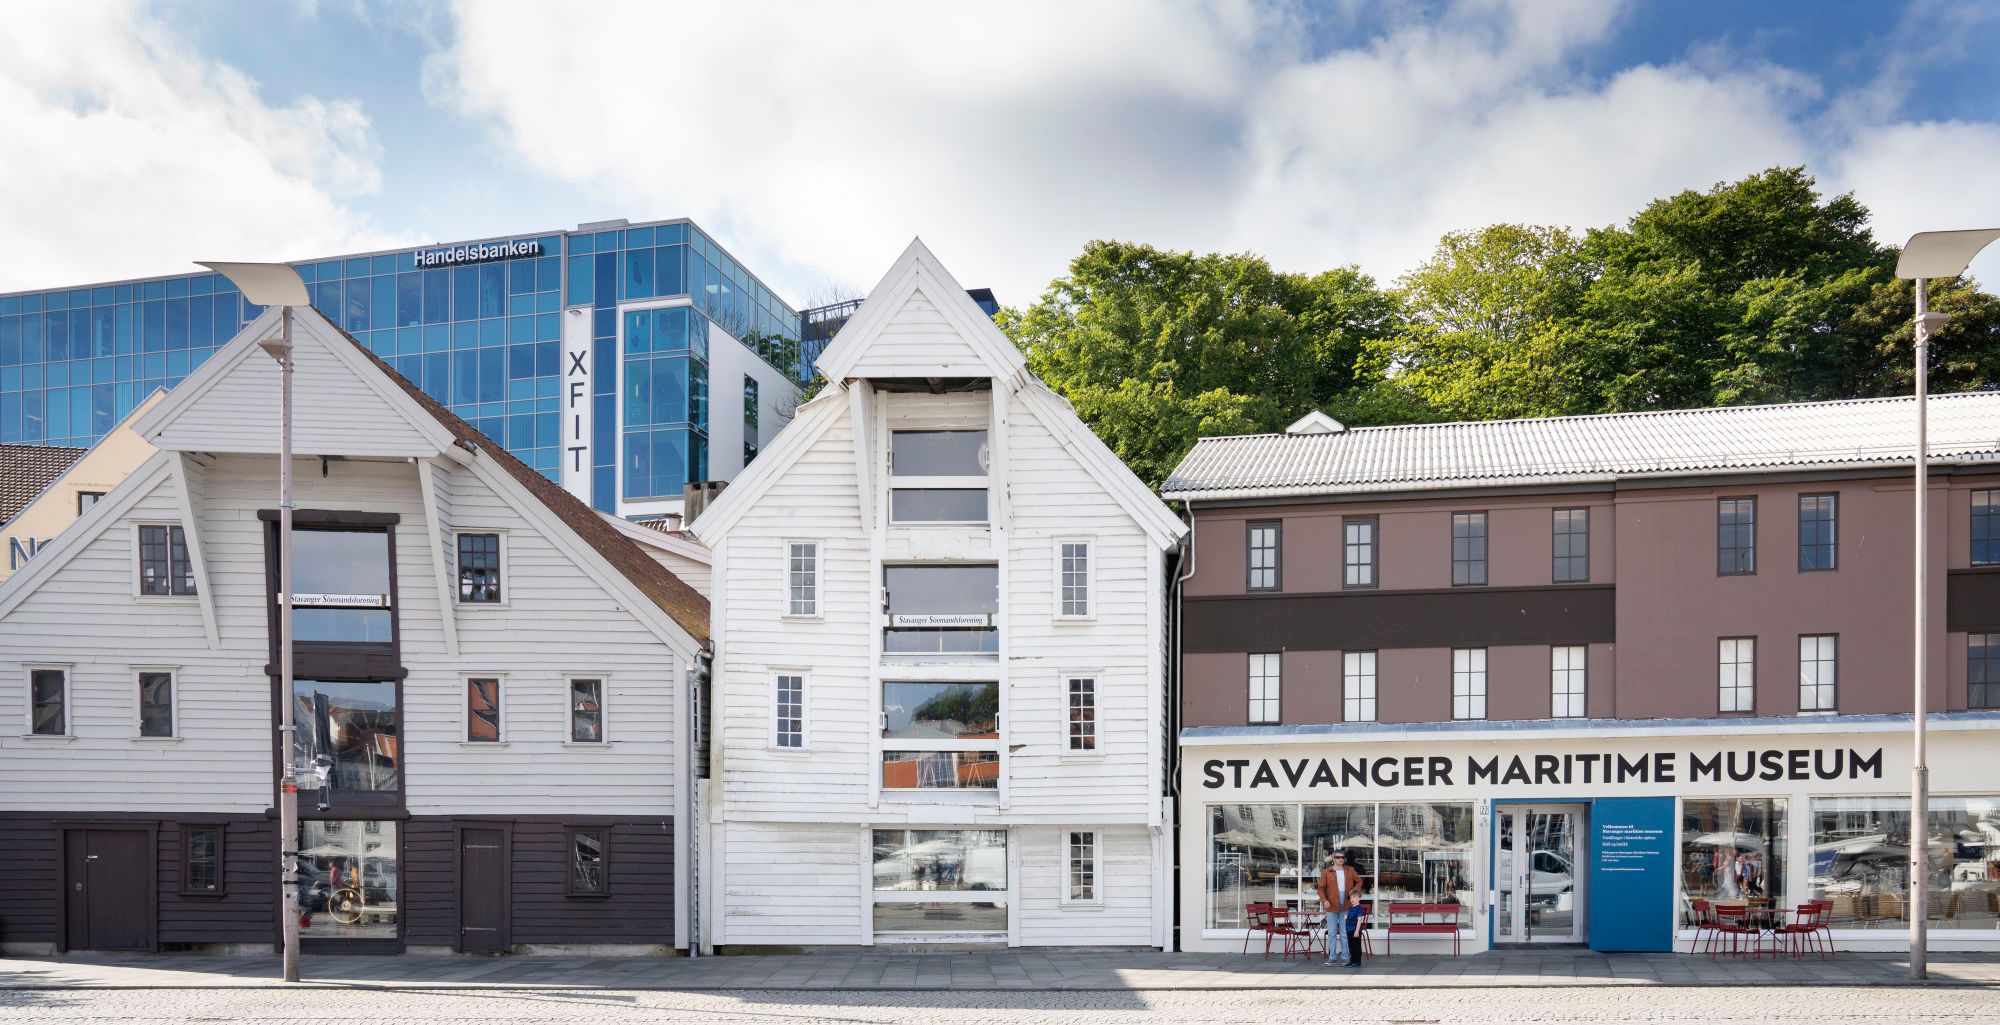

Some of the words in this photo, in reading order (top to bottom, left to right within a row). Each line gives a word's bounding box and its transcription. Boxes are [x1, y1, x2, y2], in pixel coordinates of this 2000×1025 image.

[414, 240, 539, 266] Handelsbanken
[567, 350, 587, 473] XFIT
[899, 615, 928, 625] Stavanger
[1202, 757, 1454, 789] STAVANGER
[1467, 753, 1676, 785] MARITIME
[1690, 748, 1883, 782] MUSEUM
